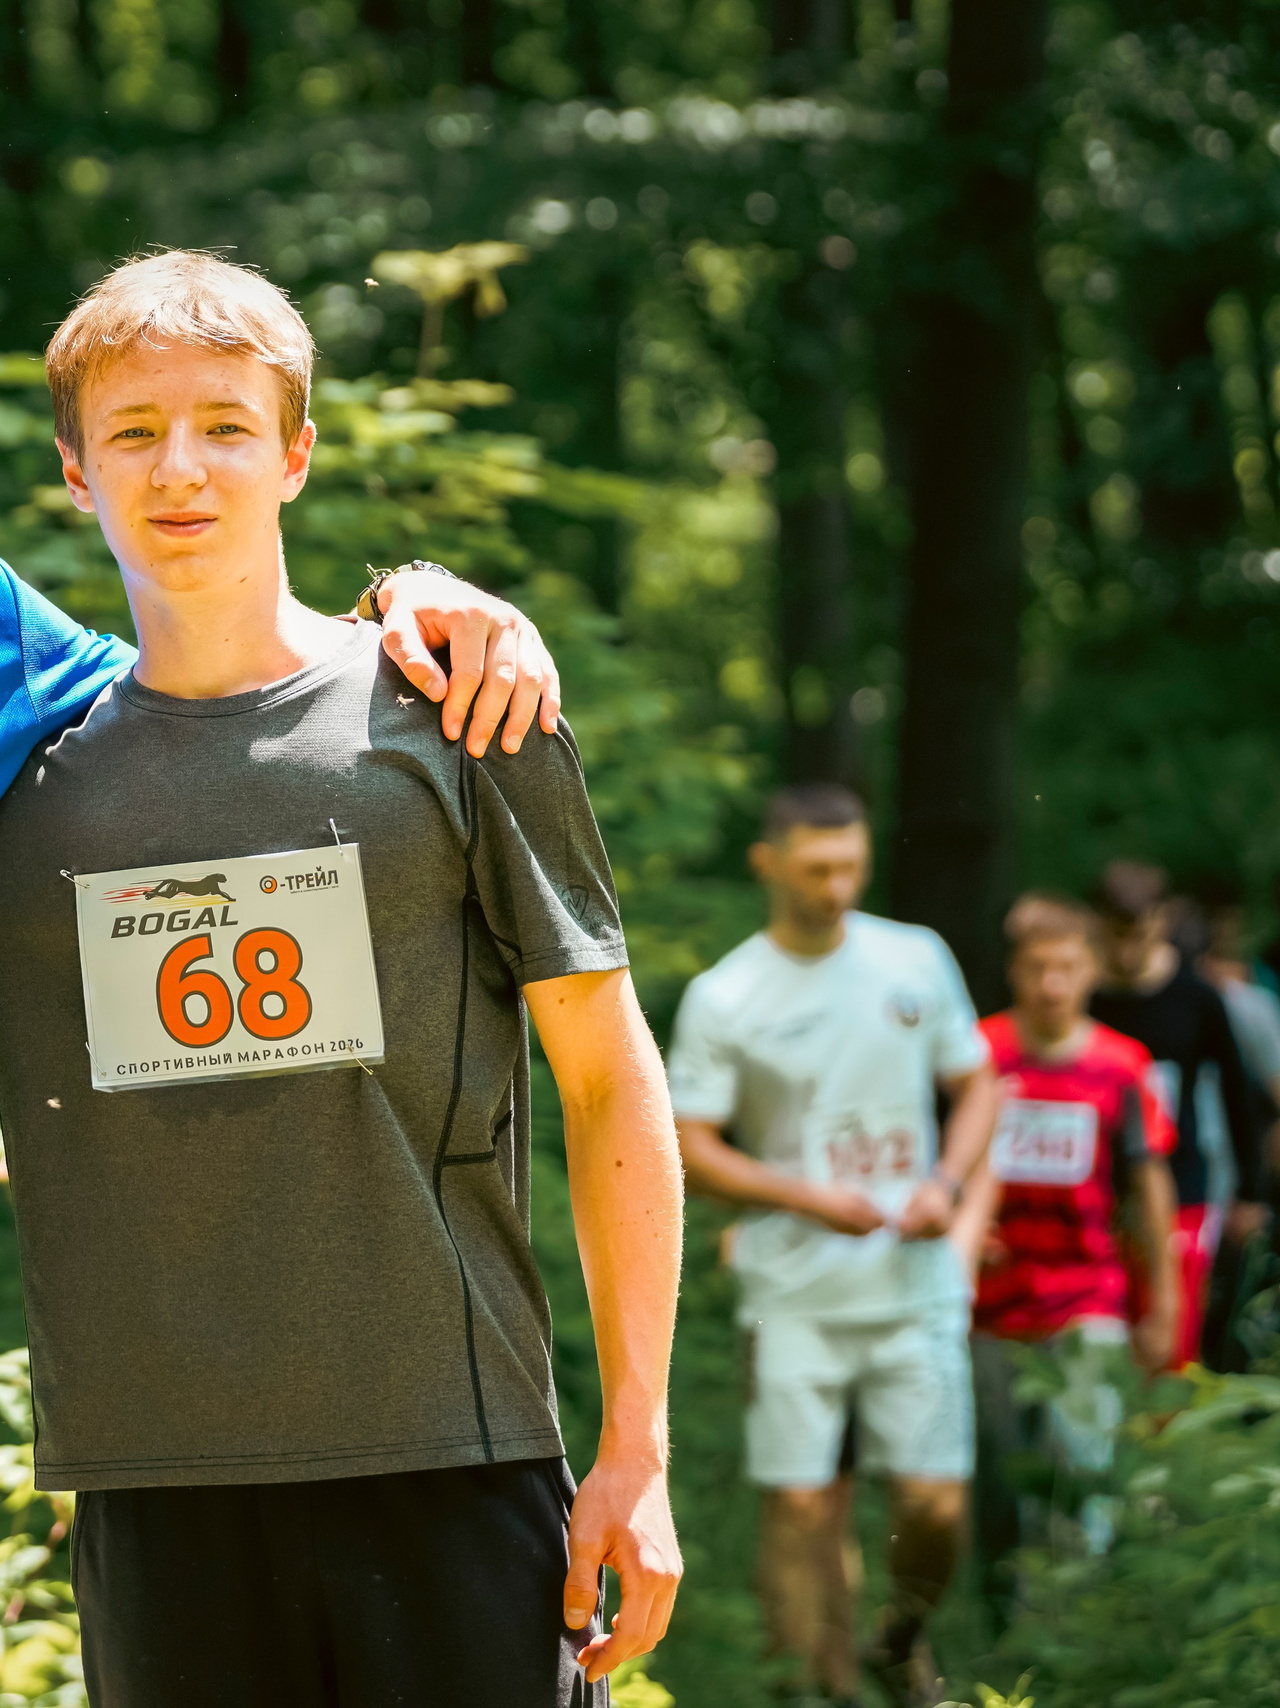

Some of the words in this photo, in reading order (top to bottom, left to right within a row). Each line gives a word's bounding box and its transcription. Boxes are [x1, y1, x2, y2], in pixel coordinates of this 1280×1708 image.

[110, 905, 239, 939] BOGAL
[155, 926, 313, 1049] 68
[116, 1052, 233, 1076] СПОРТИВНЫЙ
[237, 1042, 326, 1063] МАРАФОН
